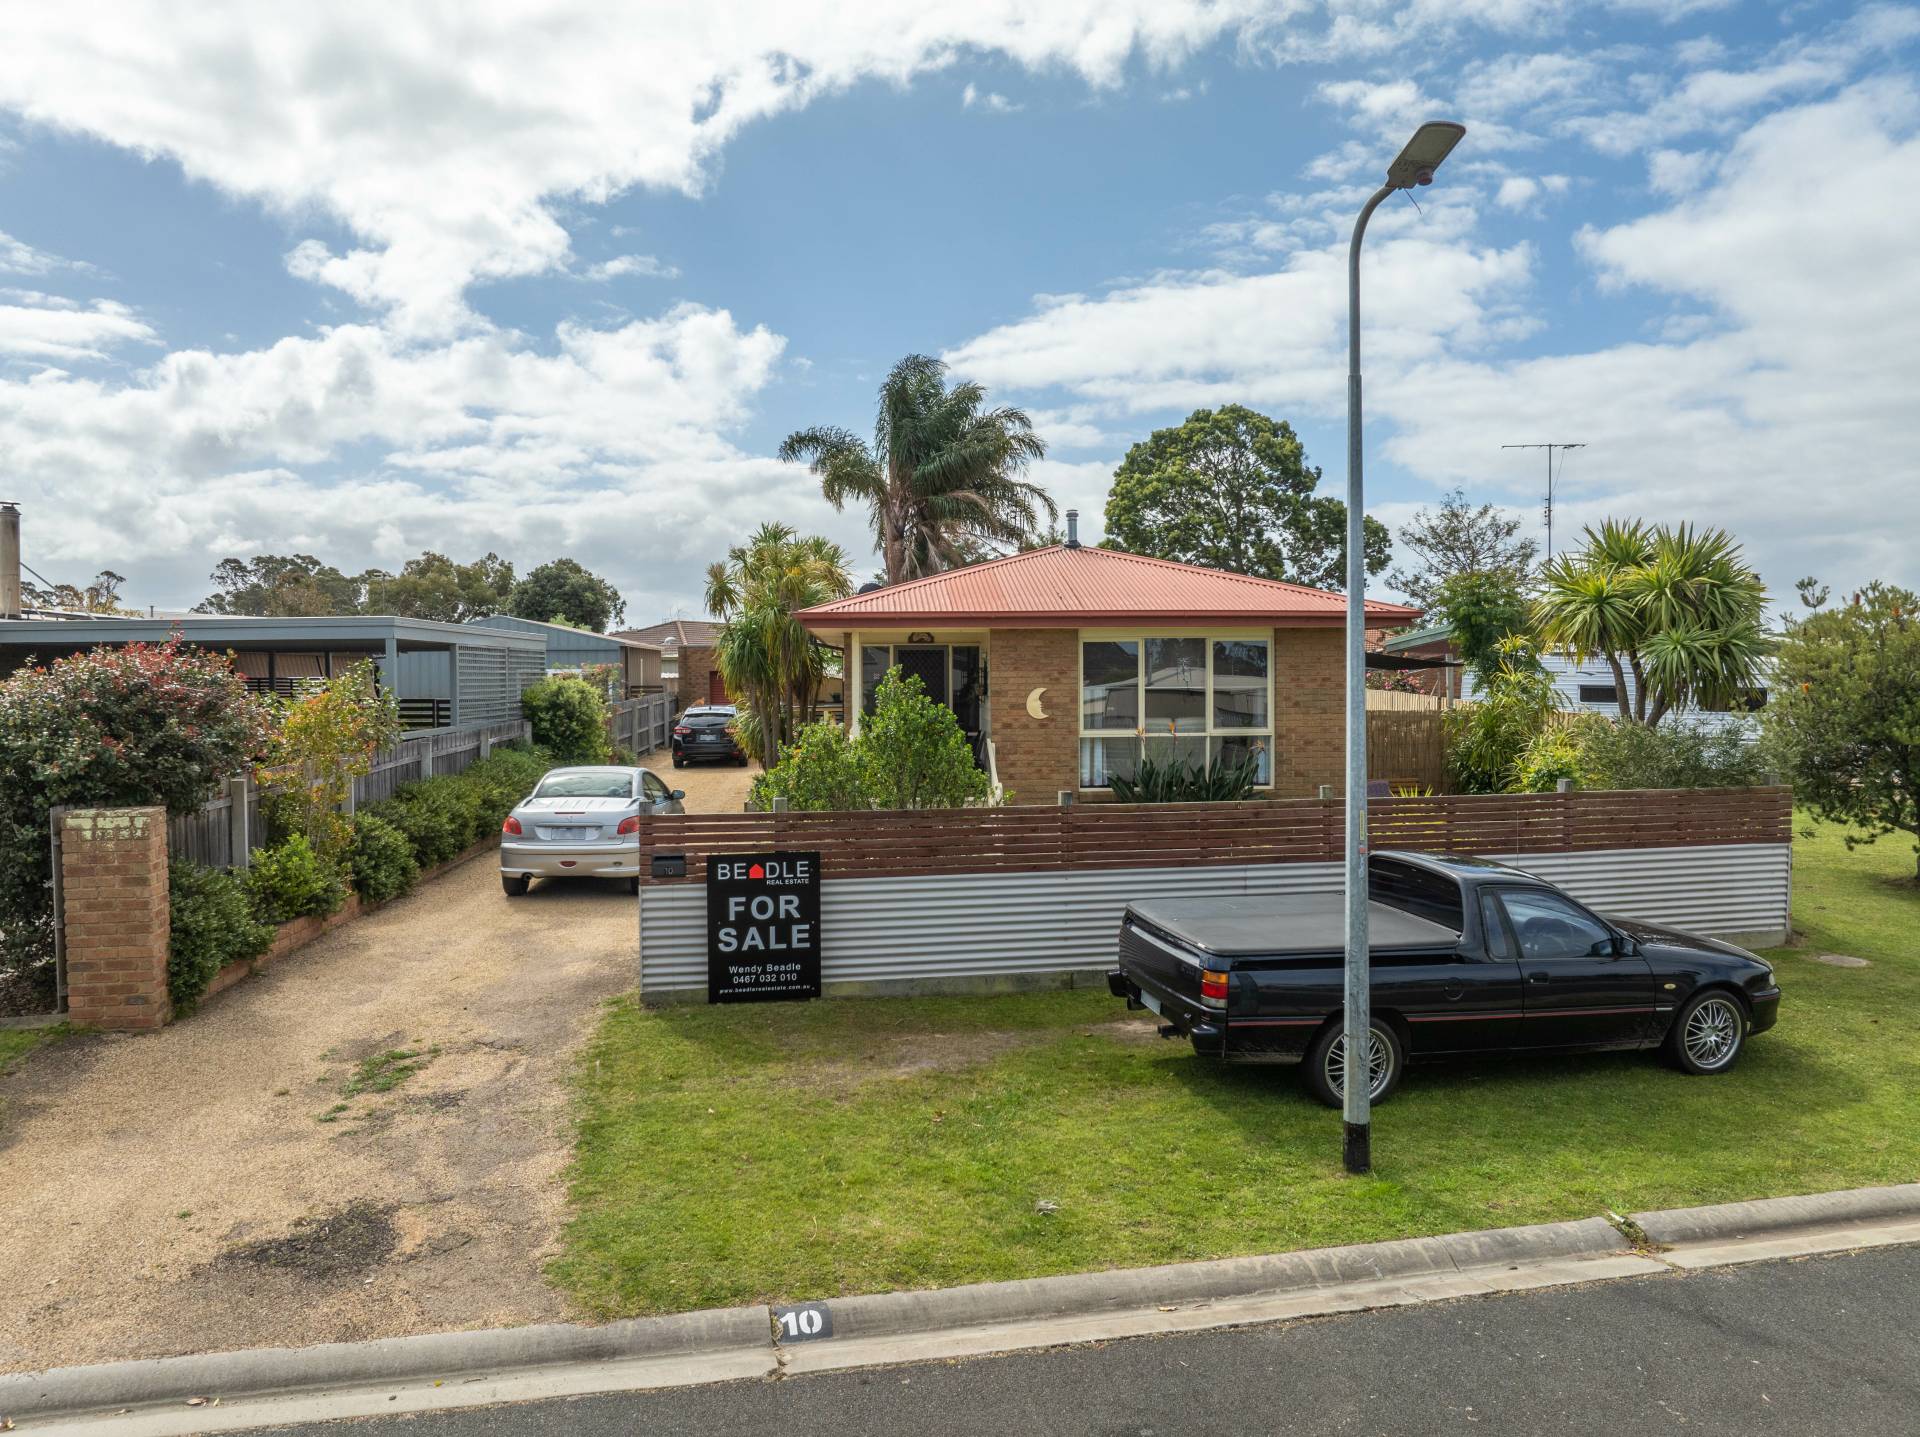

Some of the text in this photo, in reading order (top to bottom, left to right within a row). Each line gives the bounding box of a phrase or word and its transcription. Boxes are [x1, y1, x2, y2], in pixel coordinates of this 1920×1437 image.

[717, 861, 810, 880] BEDLE
[728, 895, 800, 920] FOR
[718, 924, 810, 952] SALE
[729, 962, 801, 974] Wendy Beadle
[733, 973, 797, 984] 0467 032 010
[780, 1310, 822, 1336] 10
